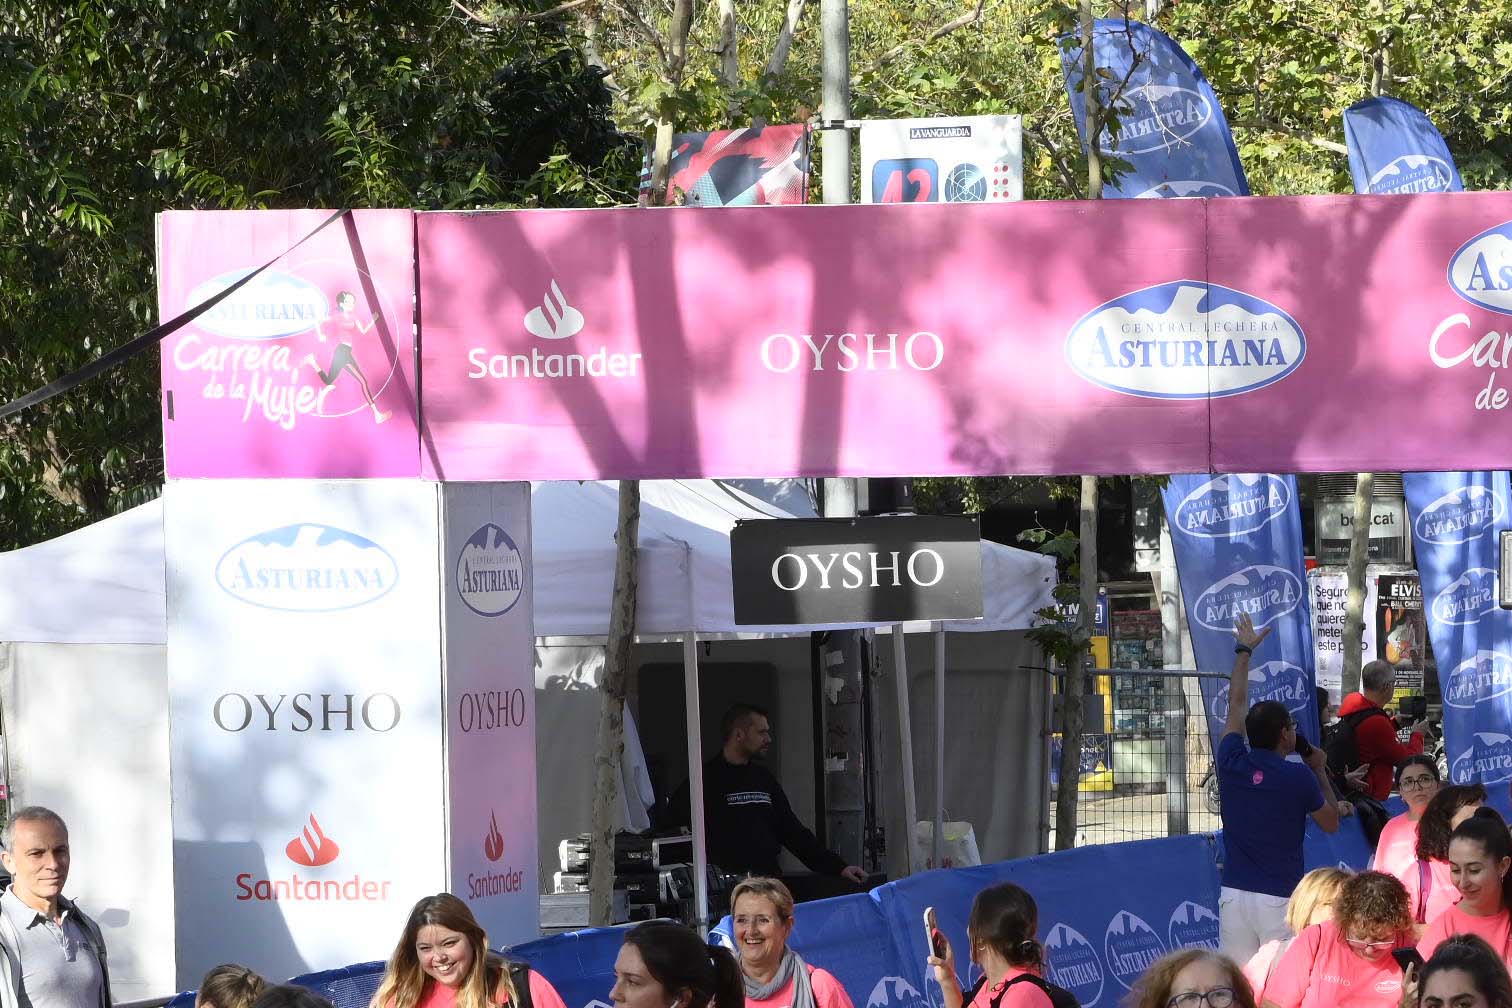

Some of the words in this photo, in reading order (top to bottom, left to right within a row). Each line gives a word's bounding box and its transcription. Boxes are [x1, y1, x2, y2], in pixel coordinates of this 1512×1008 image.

[921, 127, 970, 138] VANGUARDIA
[1121, 322, 1196, 333] CENTRAL
[1204, 321, 1279, 332] LECHERA
[174, 334, 291, 372] Carrera
[468, 347, 642, 379] Santander
[760, 331, 945, 373] OYSHO
[1088, 326, 1287, 369] ASTURIANA
[203, 377, 223, 399] de
[229, 376, 245, 399] la
[243, 368, 336, 430] Mujer
[1475, 371, 1509, 410] de
[231, 557, 385, 589] ASTURIANA
[462, 562, 519, 594] ASTURIANA
[771, 548, 945, 591] OYSHO
[1391, 584, 1422, 597] ELVIS
[213, 692, 401, 733] OYSHO
[459, 688, 525, 733] OYSHO
[236, 873, 391, 900] Santander
[468, 867, 523, 900] Santander
